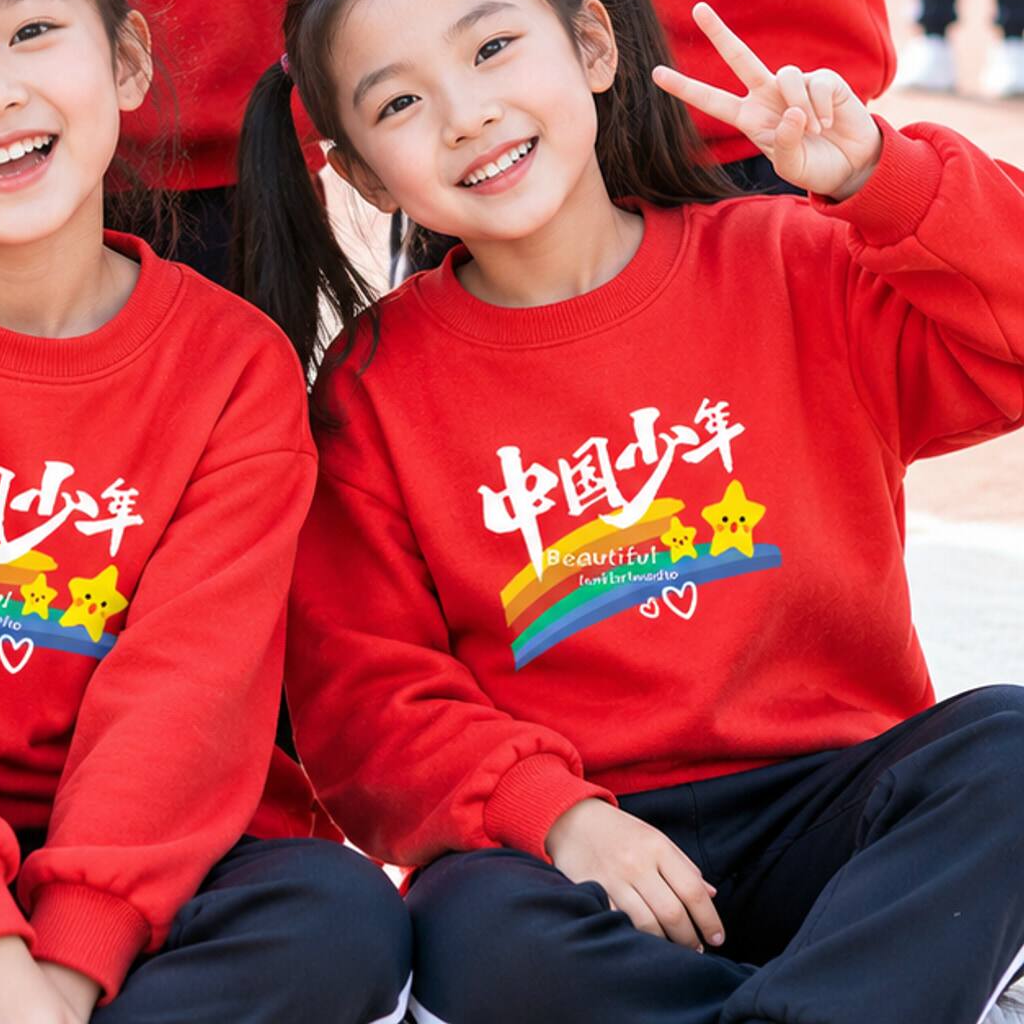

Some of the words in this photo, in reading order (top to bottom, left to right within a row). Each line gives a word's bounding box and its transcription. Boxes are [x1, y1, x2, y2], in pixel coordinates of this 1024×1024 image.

[478, 398, 745, 582] 中国少年
[546, 546, 659, 567] Beautiful
